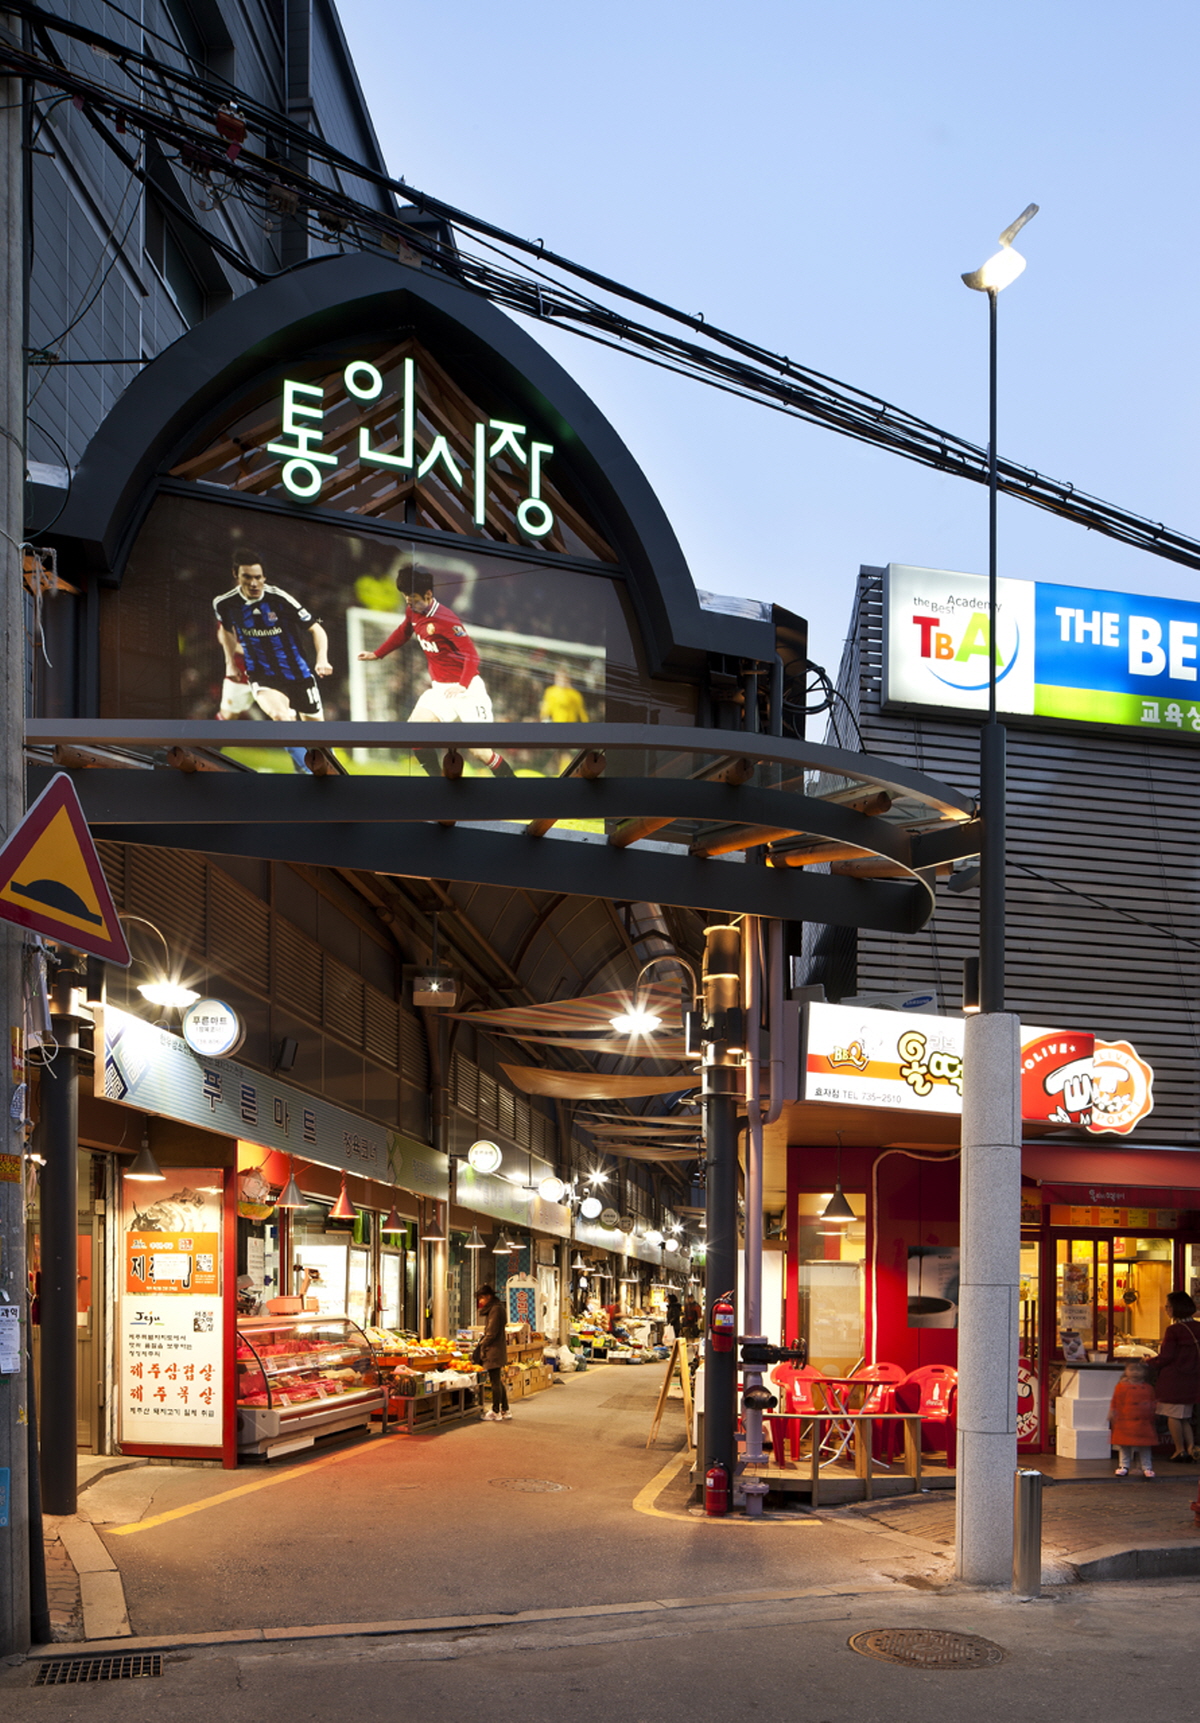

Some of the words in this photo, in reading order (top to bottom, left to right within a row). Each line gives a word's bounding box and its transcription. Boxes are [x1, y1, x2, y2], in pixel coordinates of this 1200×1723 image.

[267, 358, 555, 540] 통인시장
[913, 597, 930, 607] the
[931, 602, 955, 614] Best
[1055, 606, 1120, 647] THE
[912, 612, 1004, 667] TBA
[475, 705, 487, 720] 13
[192, 1015, 228, 1026] 푸른마트
[833, 1041, 864, 1066] BBQ
[1024, 1043, 1068, 1070] OLIVE
[202, 1068, 318, 1144] 푸른마트
[842, 1090, 858, 1100] TEL
[862, 1092, 902, 1103] 735-2510
[134, 1311, 160, 1325] Jeju
